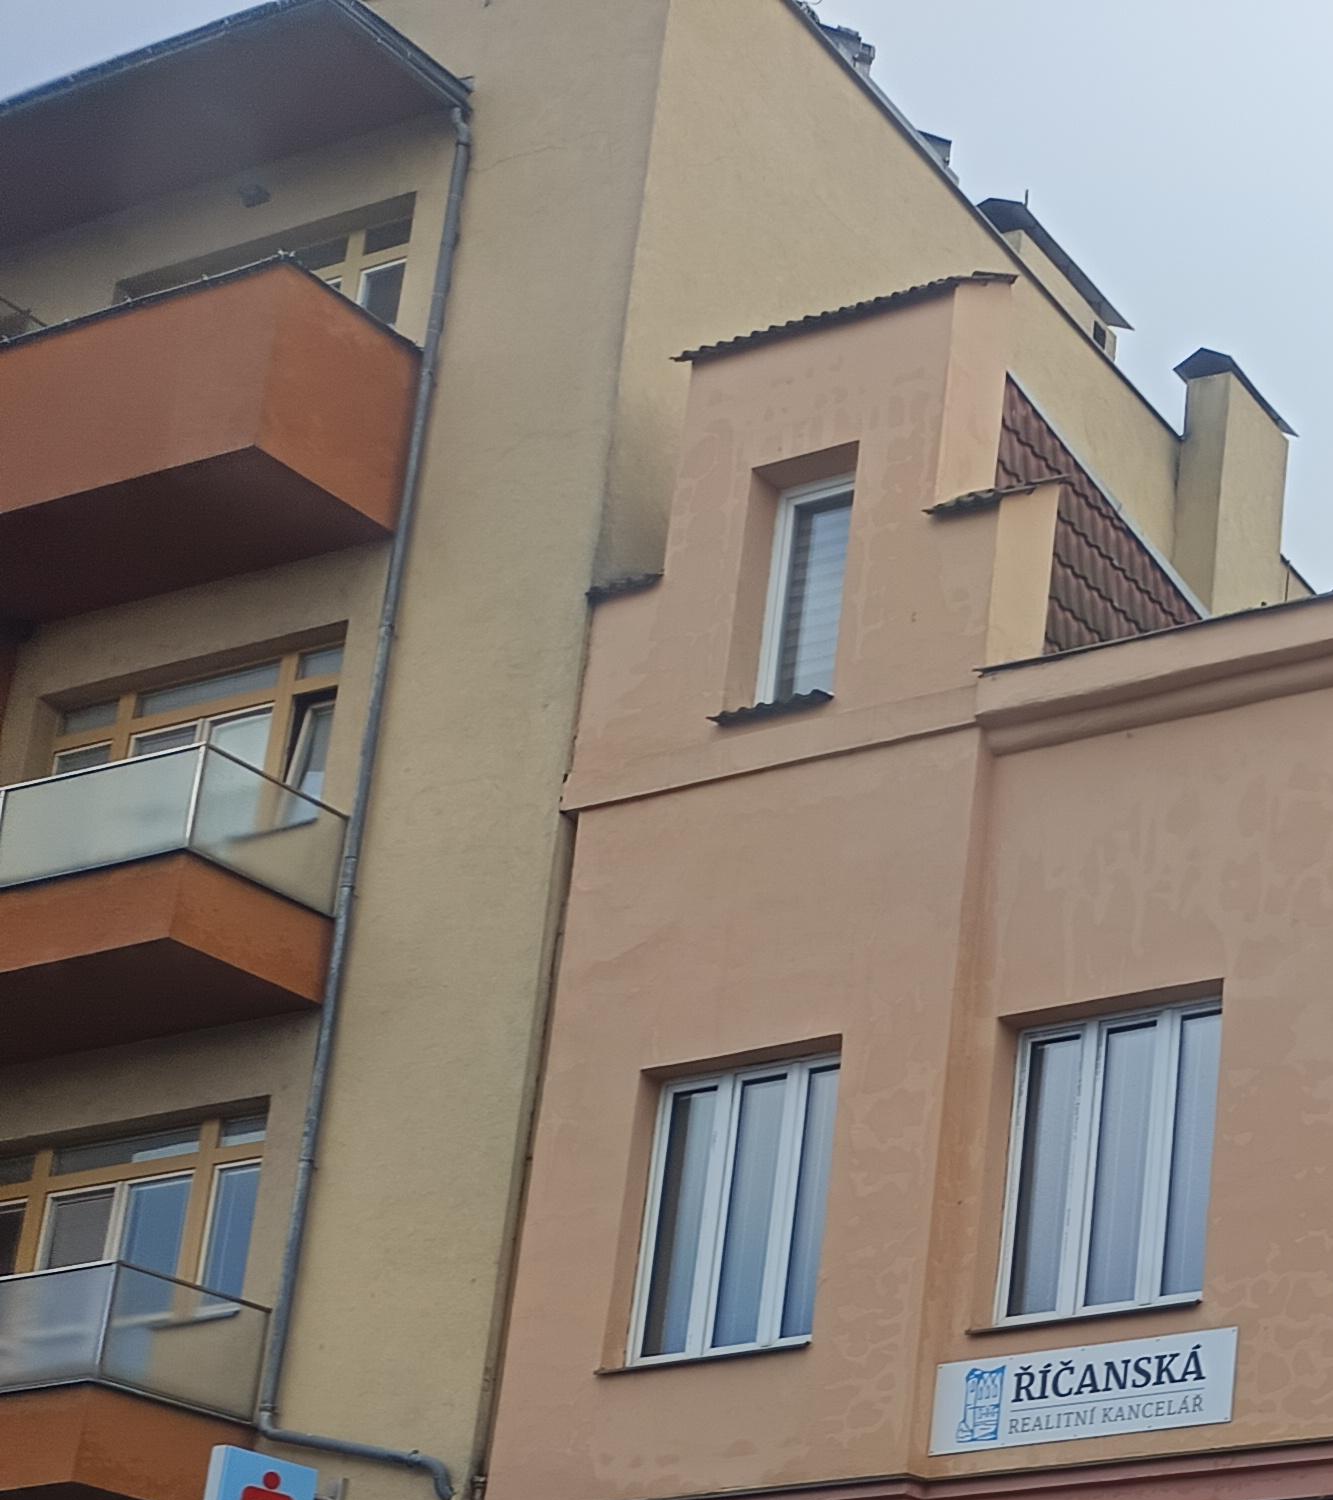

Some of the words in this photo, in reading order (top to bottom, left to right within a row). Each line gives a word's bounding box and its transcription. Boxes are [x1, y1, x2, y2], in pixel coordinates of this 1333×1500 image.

[1011, 1344, 1206, 1403] ŘÍČANSKÁ
[1008, 1407, 1097, 1435] REALITNÍ
[1101, 1395, 1204, 1424] KANCELÁŘ
